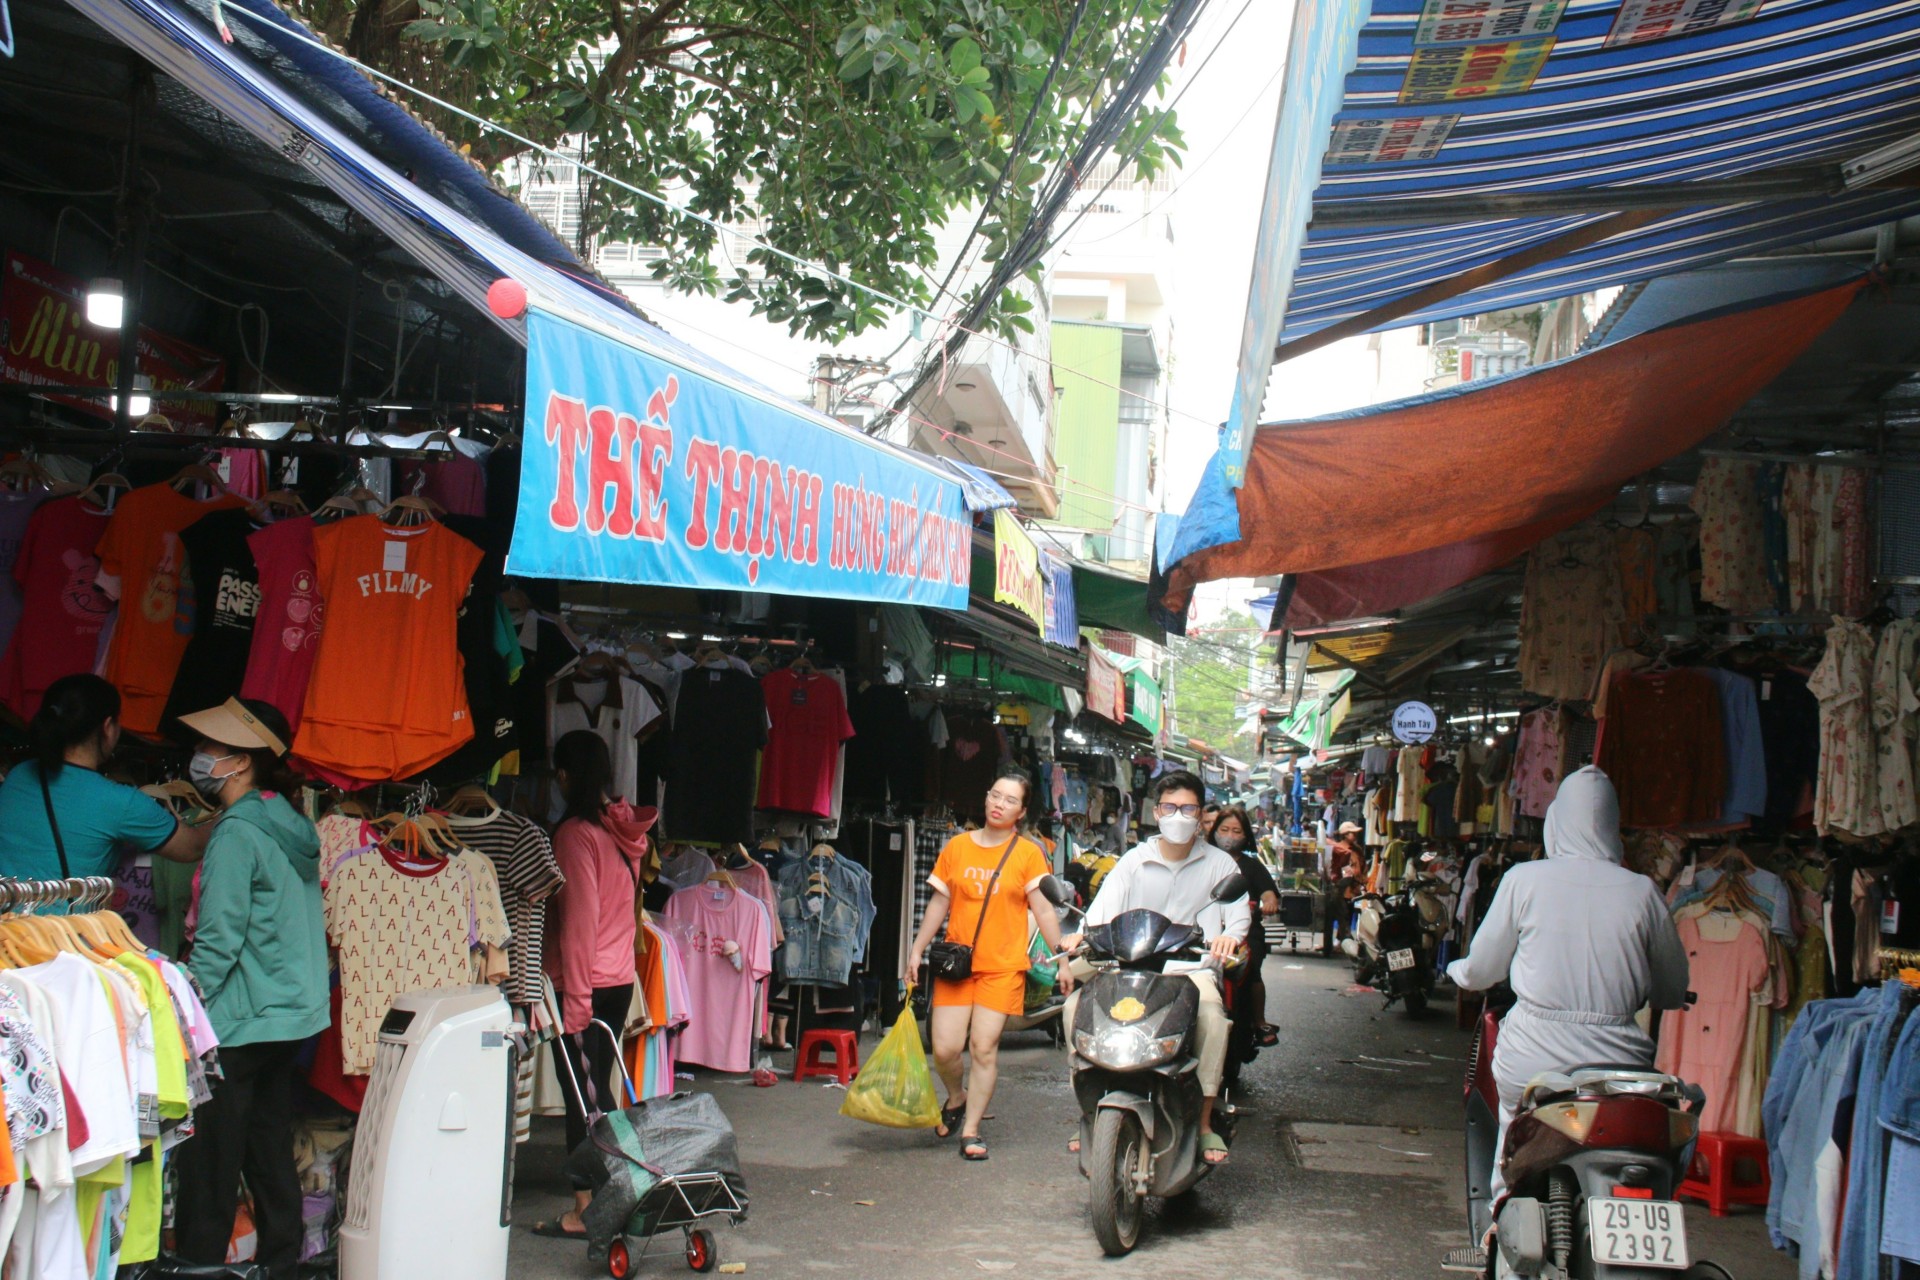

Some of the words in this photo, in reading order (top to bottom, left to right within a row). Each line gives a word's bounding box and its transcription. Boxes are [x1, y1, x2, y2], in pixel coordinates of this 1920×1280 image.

[1435, 22, 1484, 42] 555
[1460, 43, 1509, 84] XÓM
[545, 373, 680, 544] THẾ
[684, 437, 824, 586] THỊNH
[829, 471, 885, 576] HƯNG
[357, 571, 433, 601] FILMY
[1604, 1202, 1671, 1232] 29-U9
[1606, 1232, 1675, 1263] 2392
